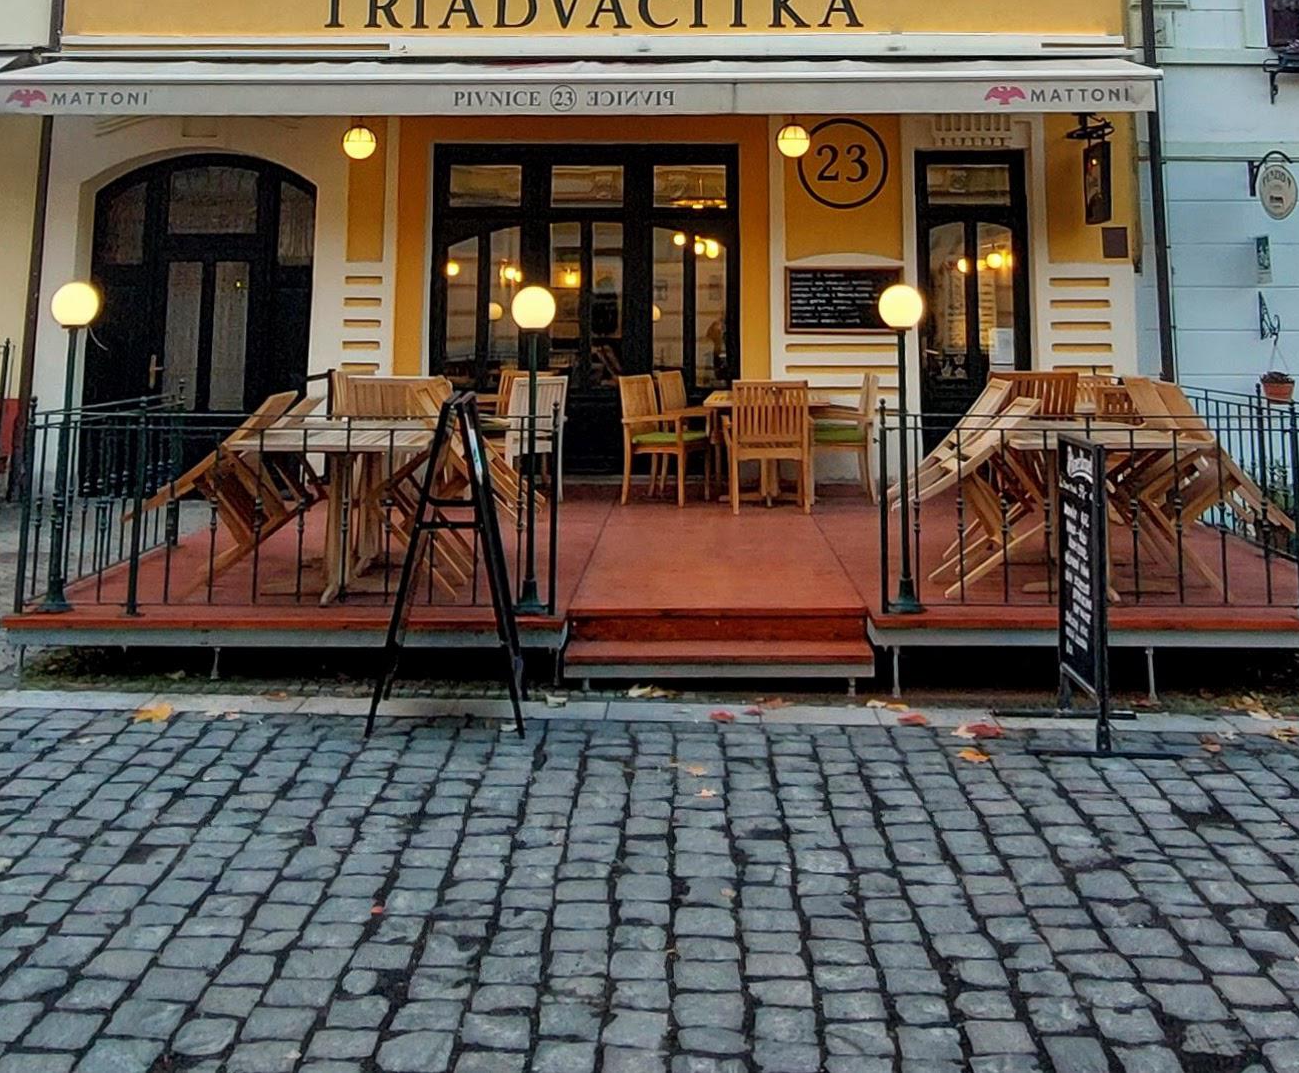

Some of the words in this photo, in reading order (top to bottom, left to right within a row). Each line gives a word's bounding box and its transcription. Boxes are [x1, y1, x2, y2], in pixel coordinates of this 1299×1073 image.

[51, 91, 149, 106] MATTONI
[453, 90, 542, 107] PIVNICE
[553, 90, 575, 107] 23
[1029, 88, 1130, 102] MATTONI
[816, 143, 870, 183] 23
